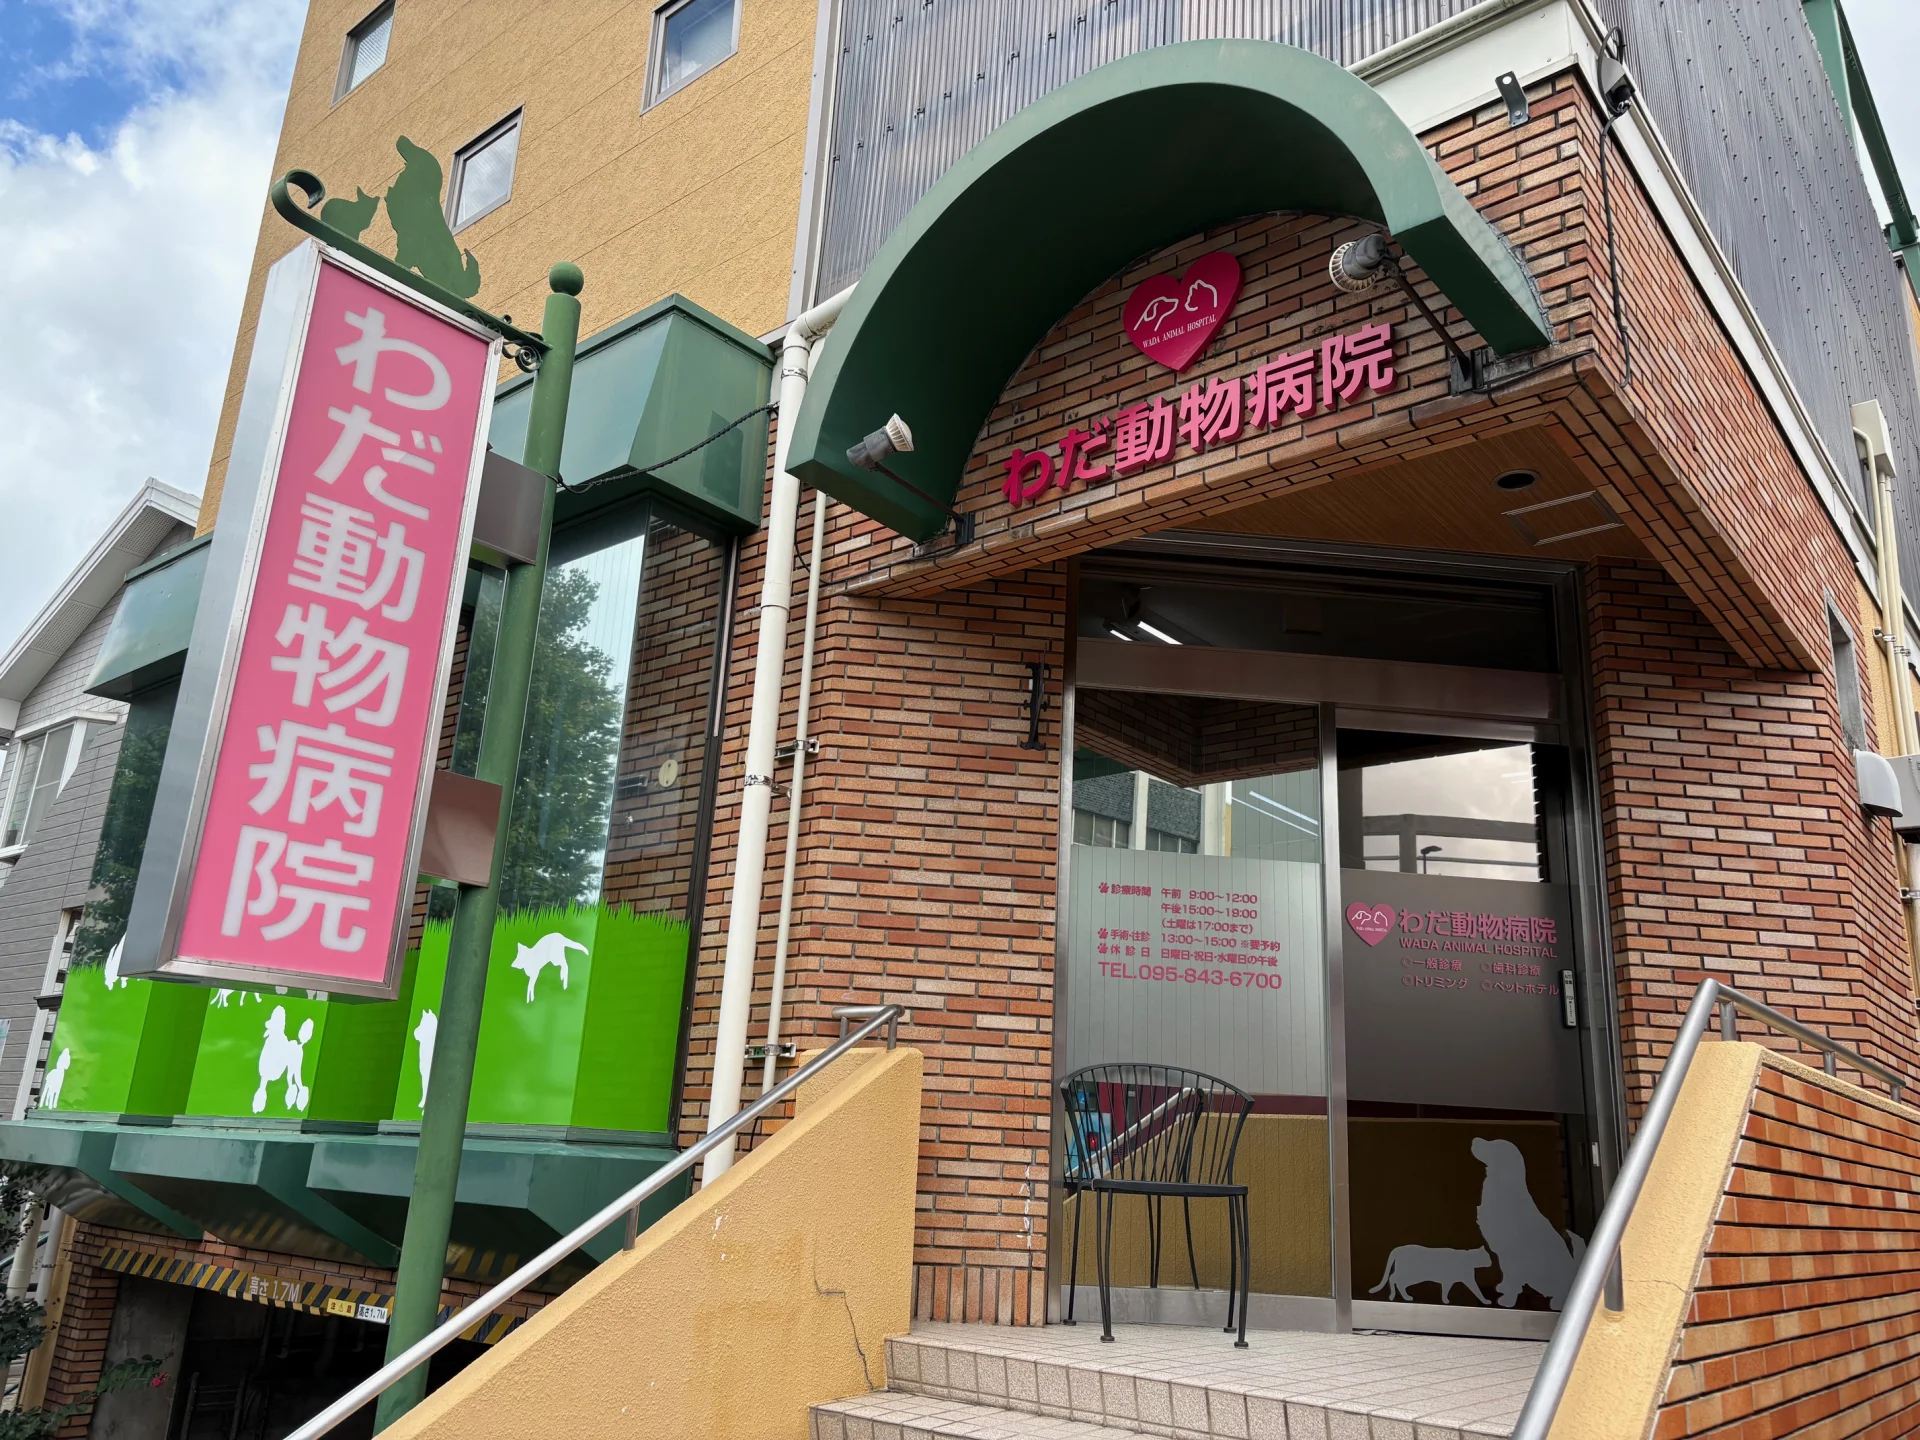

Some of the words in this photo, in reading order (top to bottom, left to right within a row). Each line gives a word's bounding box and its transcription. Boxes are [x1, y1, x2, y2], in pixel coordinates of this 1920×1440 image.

[1142, 336, 1161, 349] WADA
[1162, 326, 1185, 342] ANIMAL
[1187, 314, 1217, 332] HOSPITAL
[1002, 322, 1397, 507] わだ動物病院
[220, 306, 452, 953] わだ動物病院
[1111, 884, 1151, 896] 診療時間
[1399, 908, 1557, 944] わだ動物病院
[1400, 937, 1439, 950] WADA
[1443, 941, 1491, 955] ANIMAL
[1495, 944, 1557, 958] HOSPITAL
